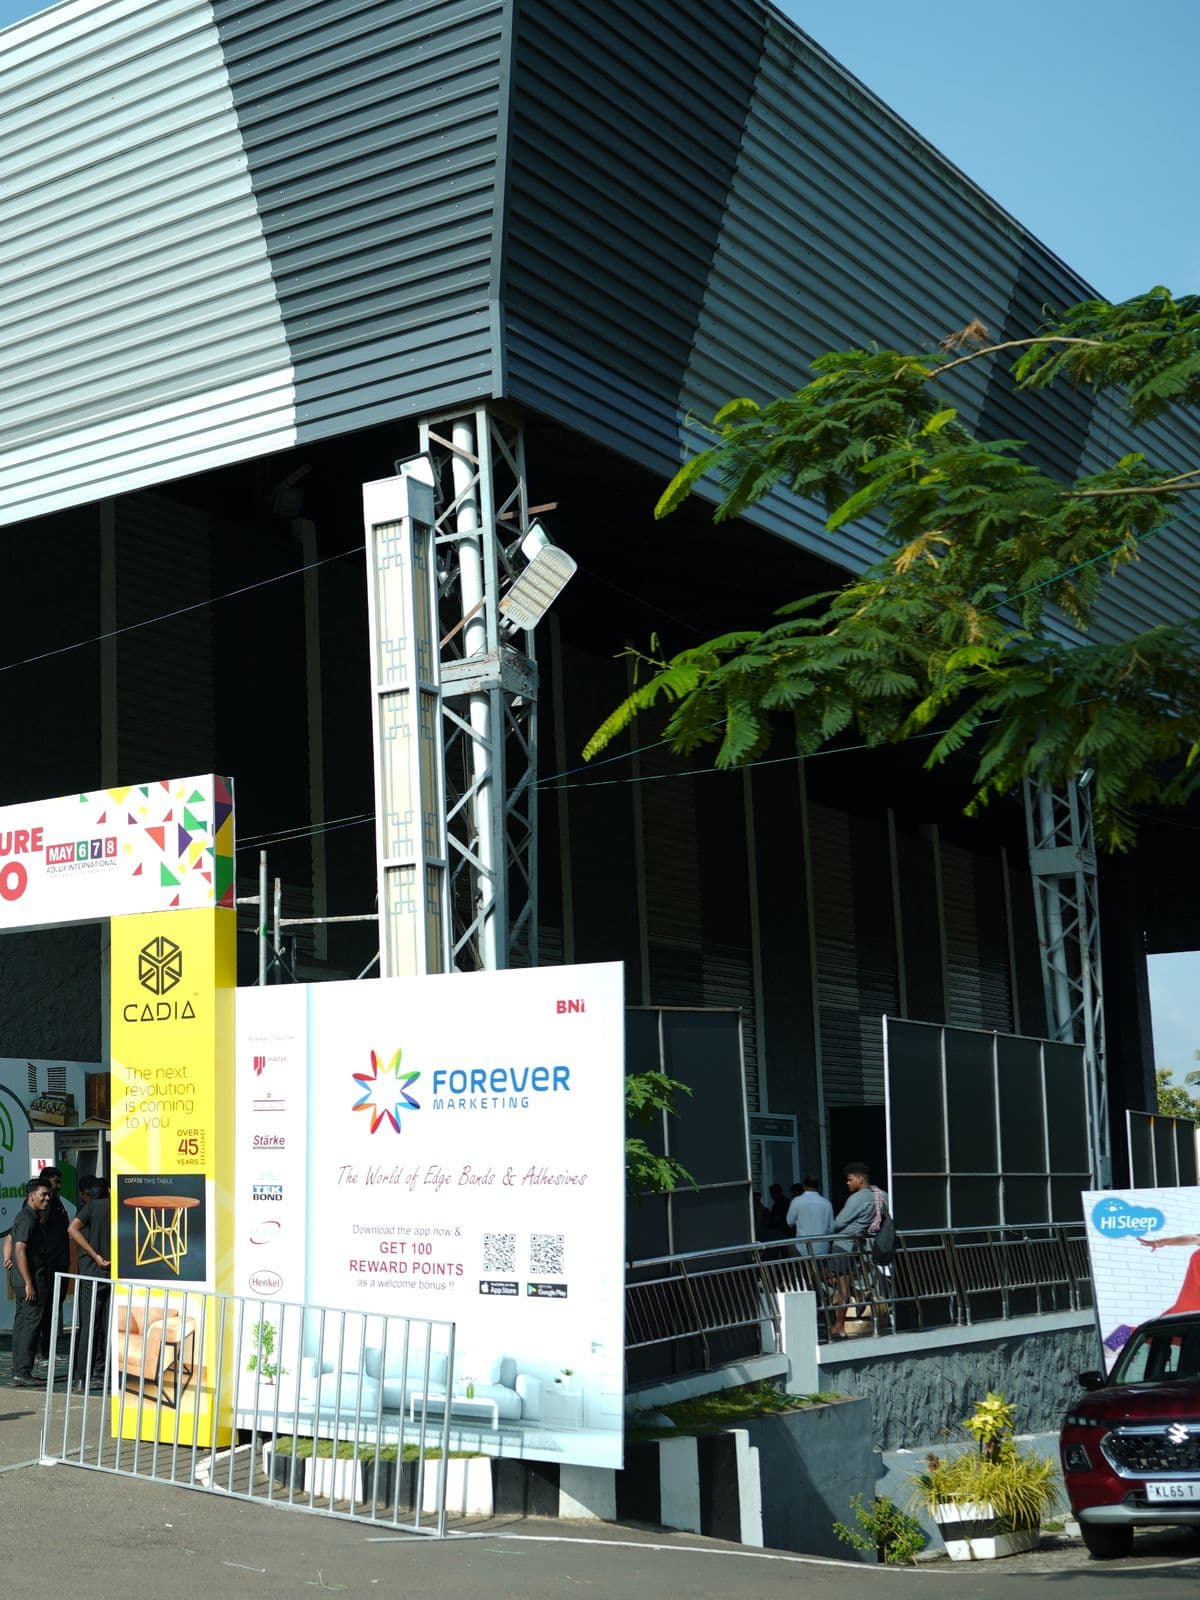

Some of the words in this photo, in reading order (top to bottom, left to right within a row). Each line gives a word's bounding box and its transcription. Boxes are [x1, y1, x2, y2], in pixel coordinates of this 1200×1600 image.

[49, 845, 73, 862] MAY
[78, 843, 87, 858] 6
[92, 842, 100, 856] 7
[106, 840, 114, 855] 8
[68, 859, 117, 871] INTERNATIONAL
[123, 1000, 196, 1022] CADIA
[126, 1066, 152, 1081] The
[156, 1065, 188, 1079] next
[125, 1082, 195, 1097] revolution
[125, 1100, 136, 1113] is
[139, 1099, 194, 1114] coming
[433, 1097, 530, 1110] MARKETING
[126, 1116, 140, 1129] to
[143, 1117, 170, 1131] you
[176, 1129, 199, 1137] OVER
[177, 1138, 199, 1156] 45
[253, 1135, 285, 1146] Stärke
[176, 1158, 199, 1166] YEARS
[337, 1165, 359, 1185] The
[365, 1165, 401, 1185] World
[405, 1166, 420, 1192] of
[424, 1165, 452, 1192] Edge
[458, 1165, 495, 1186] Bands
[502, 1166, 516, 1186] &
[521, 1165, 588, 1186] Adhesives
[253, 1193, 283, 1201] BOND
[352, 1224, 395, 1235] Download
[397, 1226, 411, 1236] the
[414, 1227, 430, 1237] app
[433, 1228, 451, 1236] now
[454, 1226, 461, 1237] &
[1101, 1216, 1116, 1229] Hi
[1117, 1216, 1157, 1231] Sleep
[380, 1241, 407, 1254] GET
[412, 1243, 432, 1255] 100
[349, 1259, 407, 1274] REWARD
[412, 1262, 464, 1276] POINTS
[252, 1277, 280, 1287] Henkel
[357, 1279, 367, 1287] as
[377, 1279, 416, 1289] welcome
[419, 1280, 446, 1290] bonus
[1155, 1486, 1184, 1497] KL65
